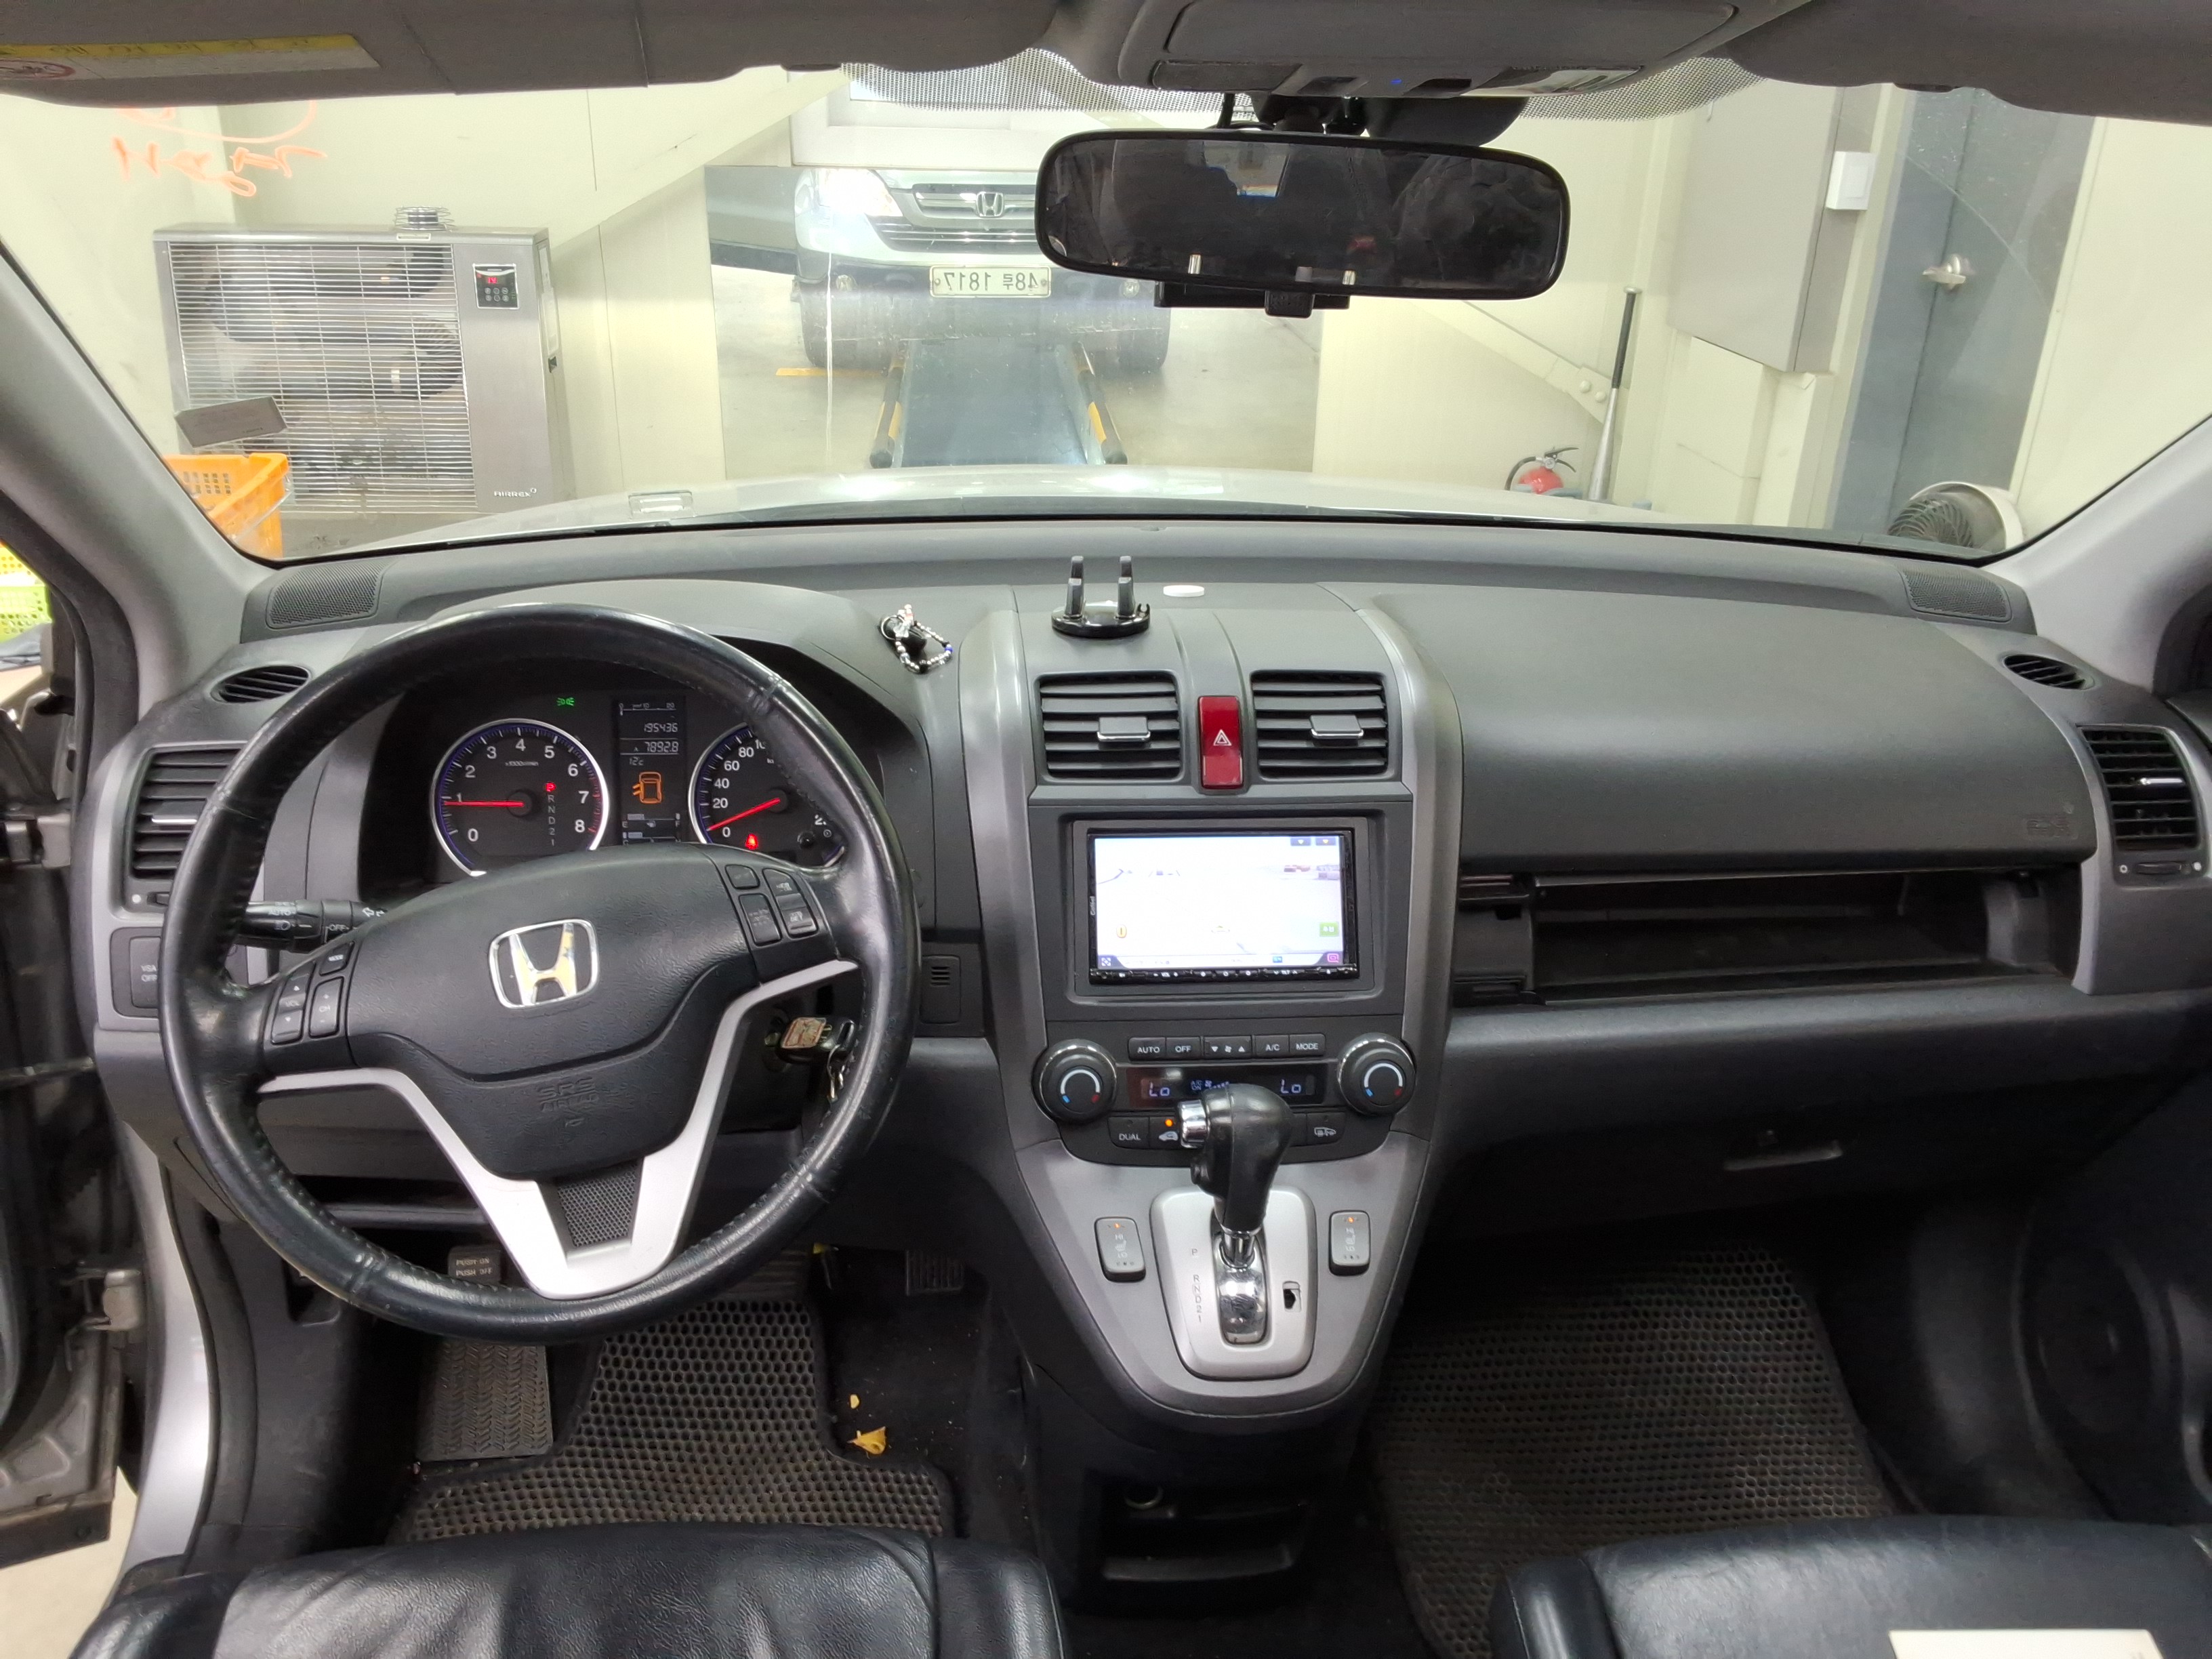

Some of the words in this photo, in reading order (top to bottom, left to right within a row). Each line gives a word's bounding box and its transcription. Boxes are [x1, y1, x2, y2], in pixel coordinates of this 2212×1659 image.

[515, 739, 526, 752] 4
[487, 746, 497, 759] 3
[544, 745, 555, 758] 5
[739, 747, 754, 758] 80
[568, 764, 578, 777] 6
[724, 760, 740, 771] 60
[465, 765, 476, 778] 2
[714, 778, 730, 789] 40
[548, 795, 554, 803] R
[578, 791, 590, 804] 7
[713, 798, 729, 808] 20
[548, 817, 555, 825] D
[575, 819, 586, 833] 8
[468, 828, 478, 842] 0
[549, 827, 555, 836] 2
[722, 827, 731, 838] 0
[1265, 1043, 1280, 1051] A/C
[1296, 1042, 1319, 1050] MODE
[1119, 1132, 1141, 1141] DUAL
[1193, 1274, 1200, 1282] R
[1195, 1295, 1202, 1303] D
